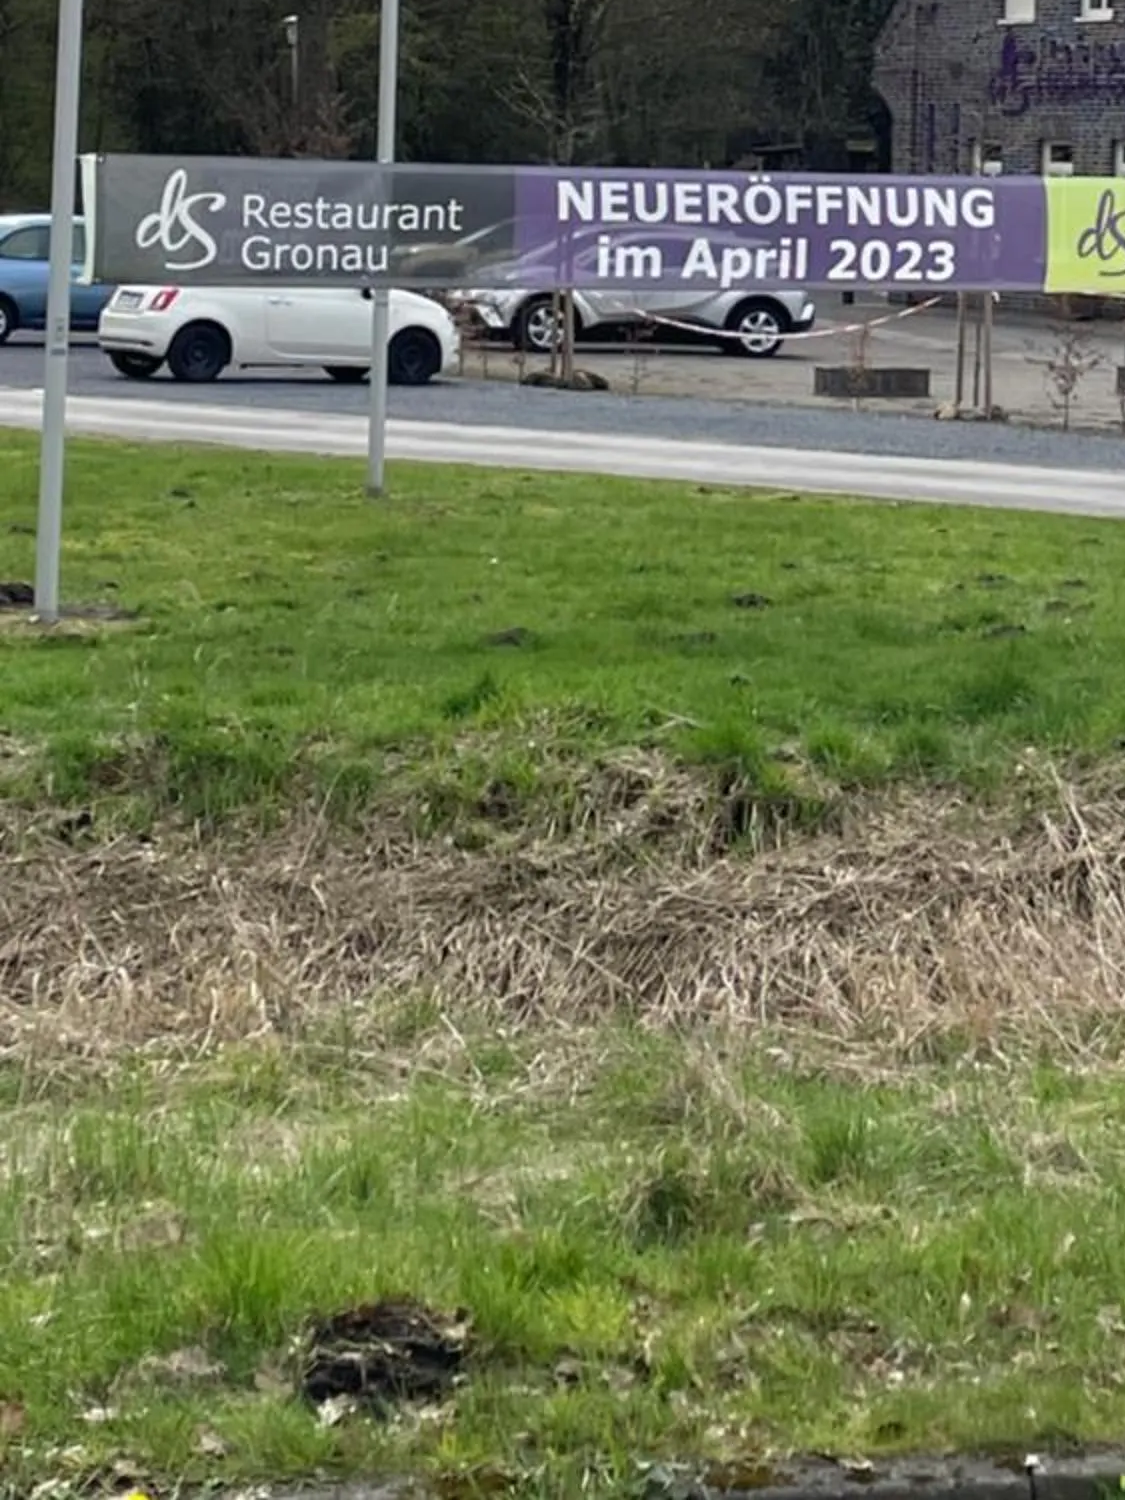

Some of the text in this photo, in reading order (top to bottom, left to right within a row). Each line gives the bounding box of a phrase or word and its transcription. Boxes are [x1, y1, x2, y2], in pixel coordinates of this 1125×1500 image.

[241, 194, 464, 232] Restaurant
[556, 174, 996, 228] NEUERÖFFNUNG
[240, 235, 389, 273] Gronau
[597, 235, 956, 289] im April 2023
